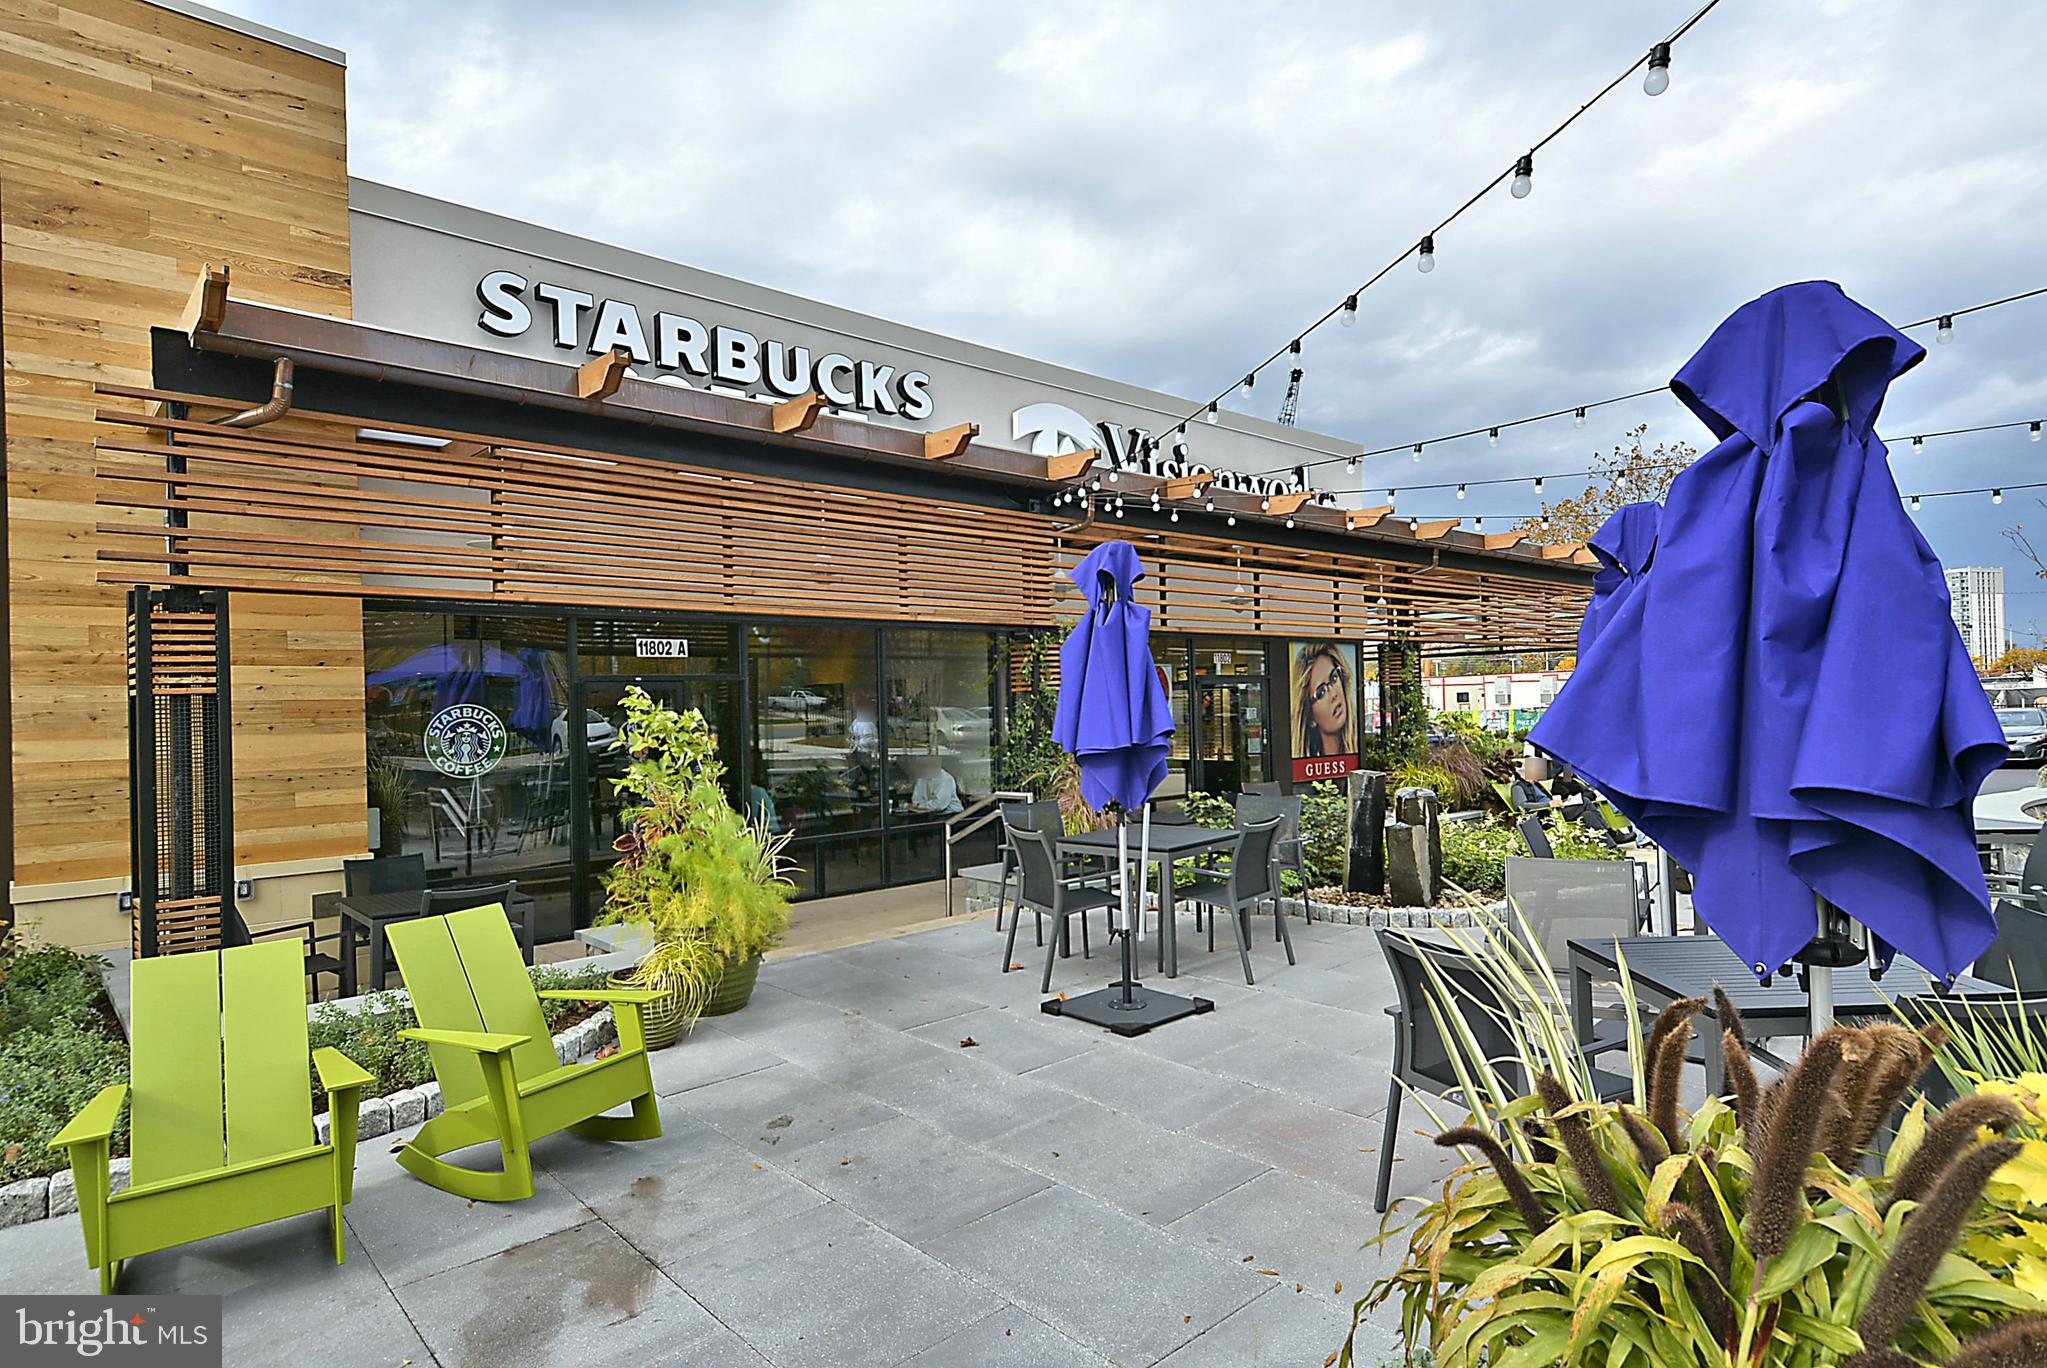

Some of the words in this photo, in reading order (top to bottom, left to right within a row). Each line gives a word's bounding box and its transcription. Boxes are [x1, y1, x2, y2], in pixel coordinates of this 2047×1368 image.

[477, 270, 935, 420] STARBUCKS
[638, 640, 672, 656] 11802
[677, 641, 686, 656] A
[429, 707, 503, 738] STARBUCKS
[436, 756, 493, 775] COFFEE
[1305, 760, 1345, 777] GUESS
